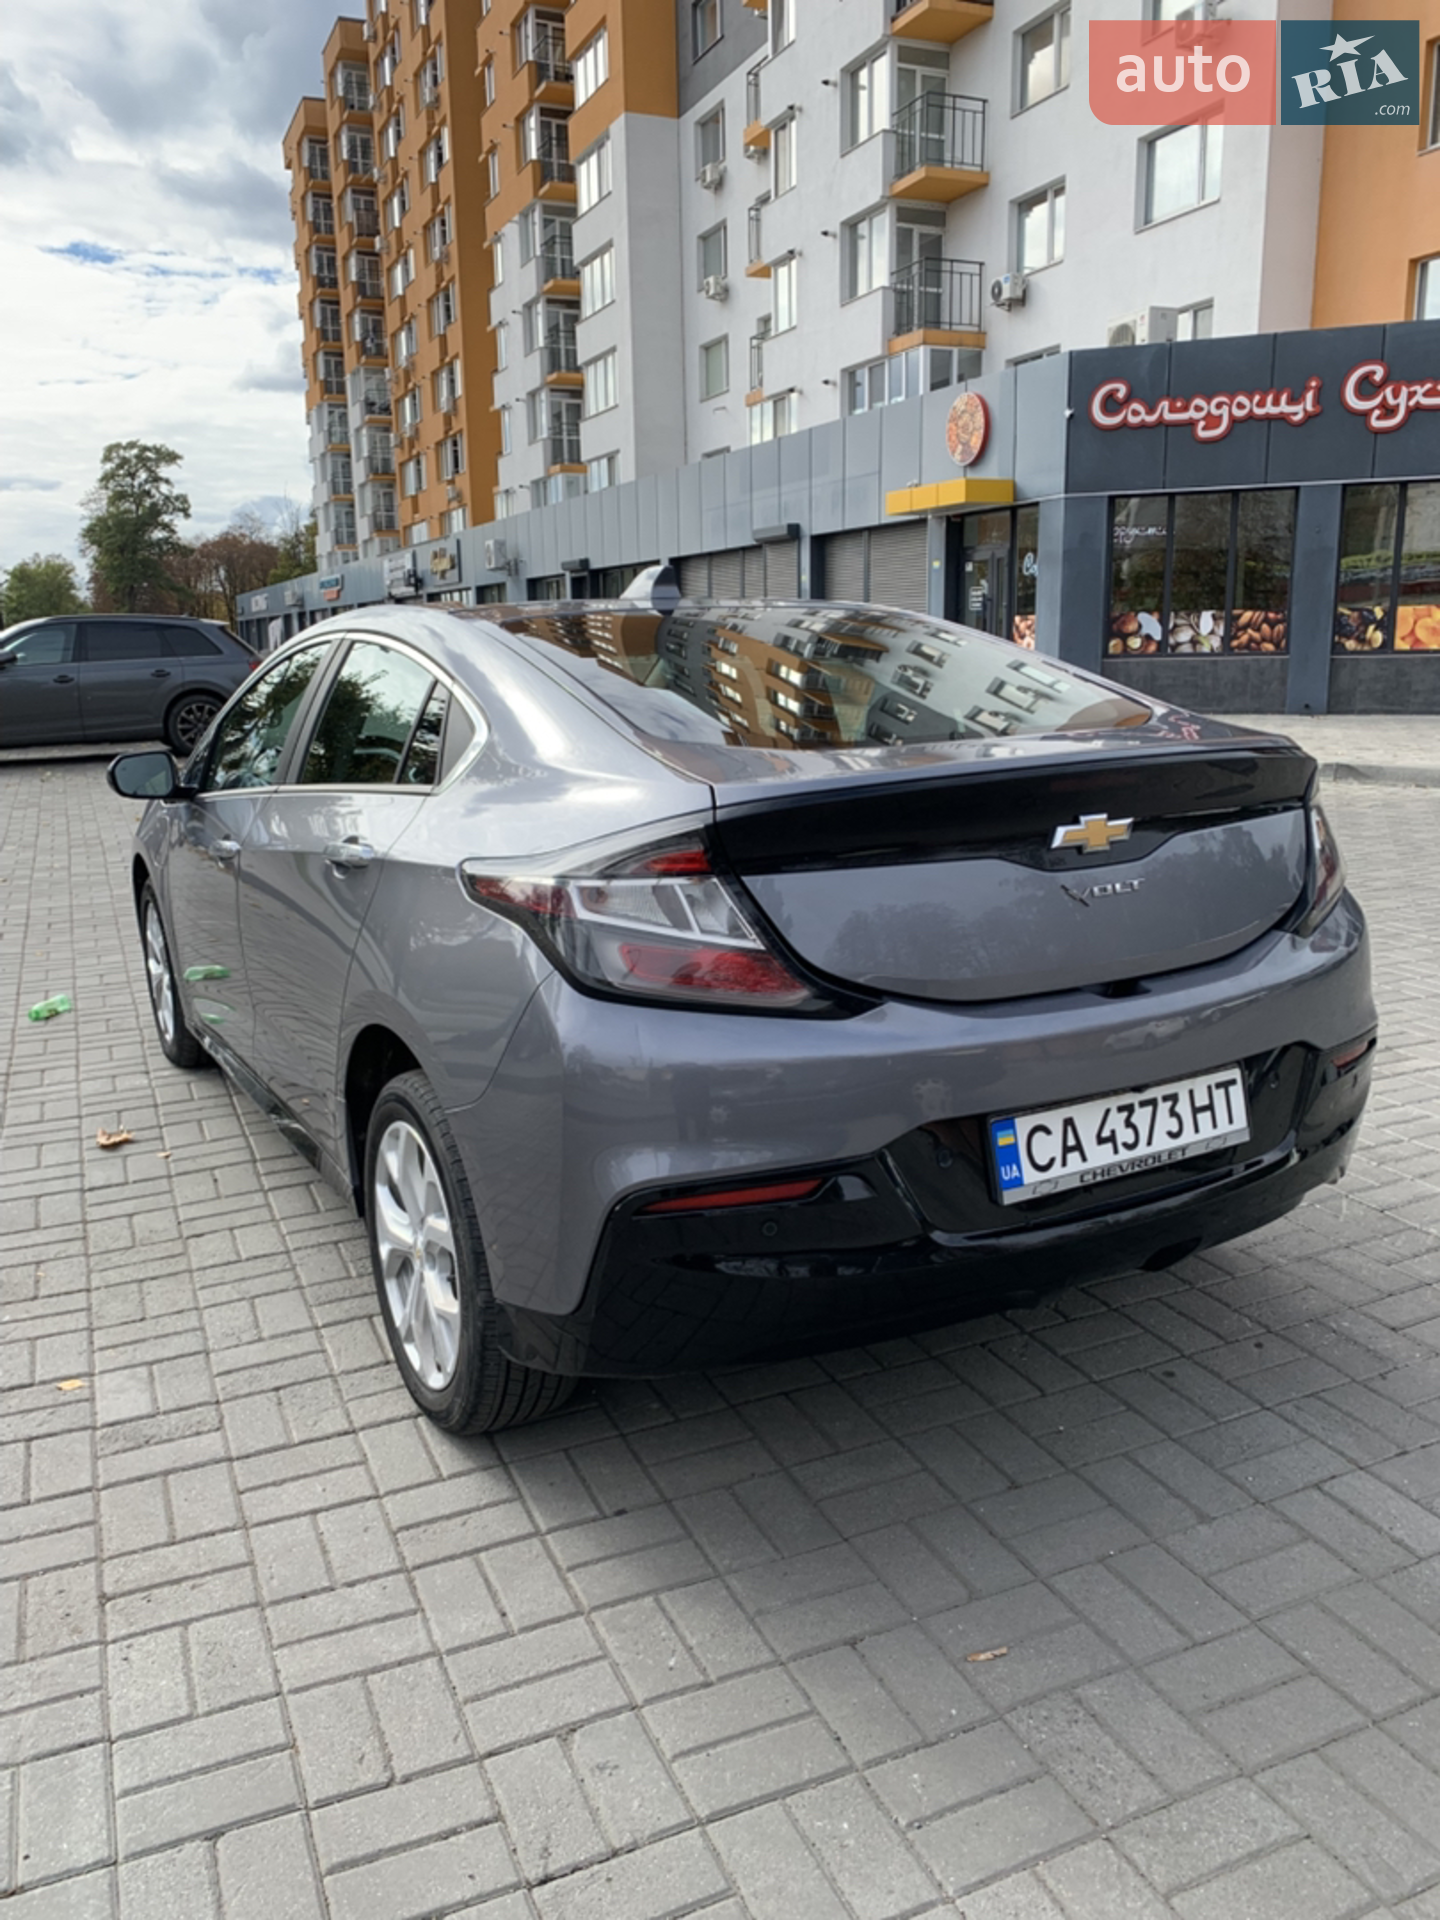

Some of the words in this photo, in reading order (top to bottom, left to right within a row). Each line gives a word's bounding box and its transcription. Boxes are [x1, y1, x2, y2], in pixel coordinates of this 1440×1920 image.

[1342, 361, 1440, 432] Сух
[1061, 877, 1145, 907] VOLT
[1026, 1116, 1087, 1172] CA
[1001, 1163, 1020, 1180] UA
[1079, 1147, 1188, 1183] CHEVROLET
